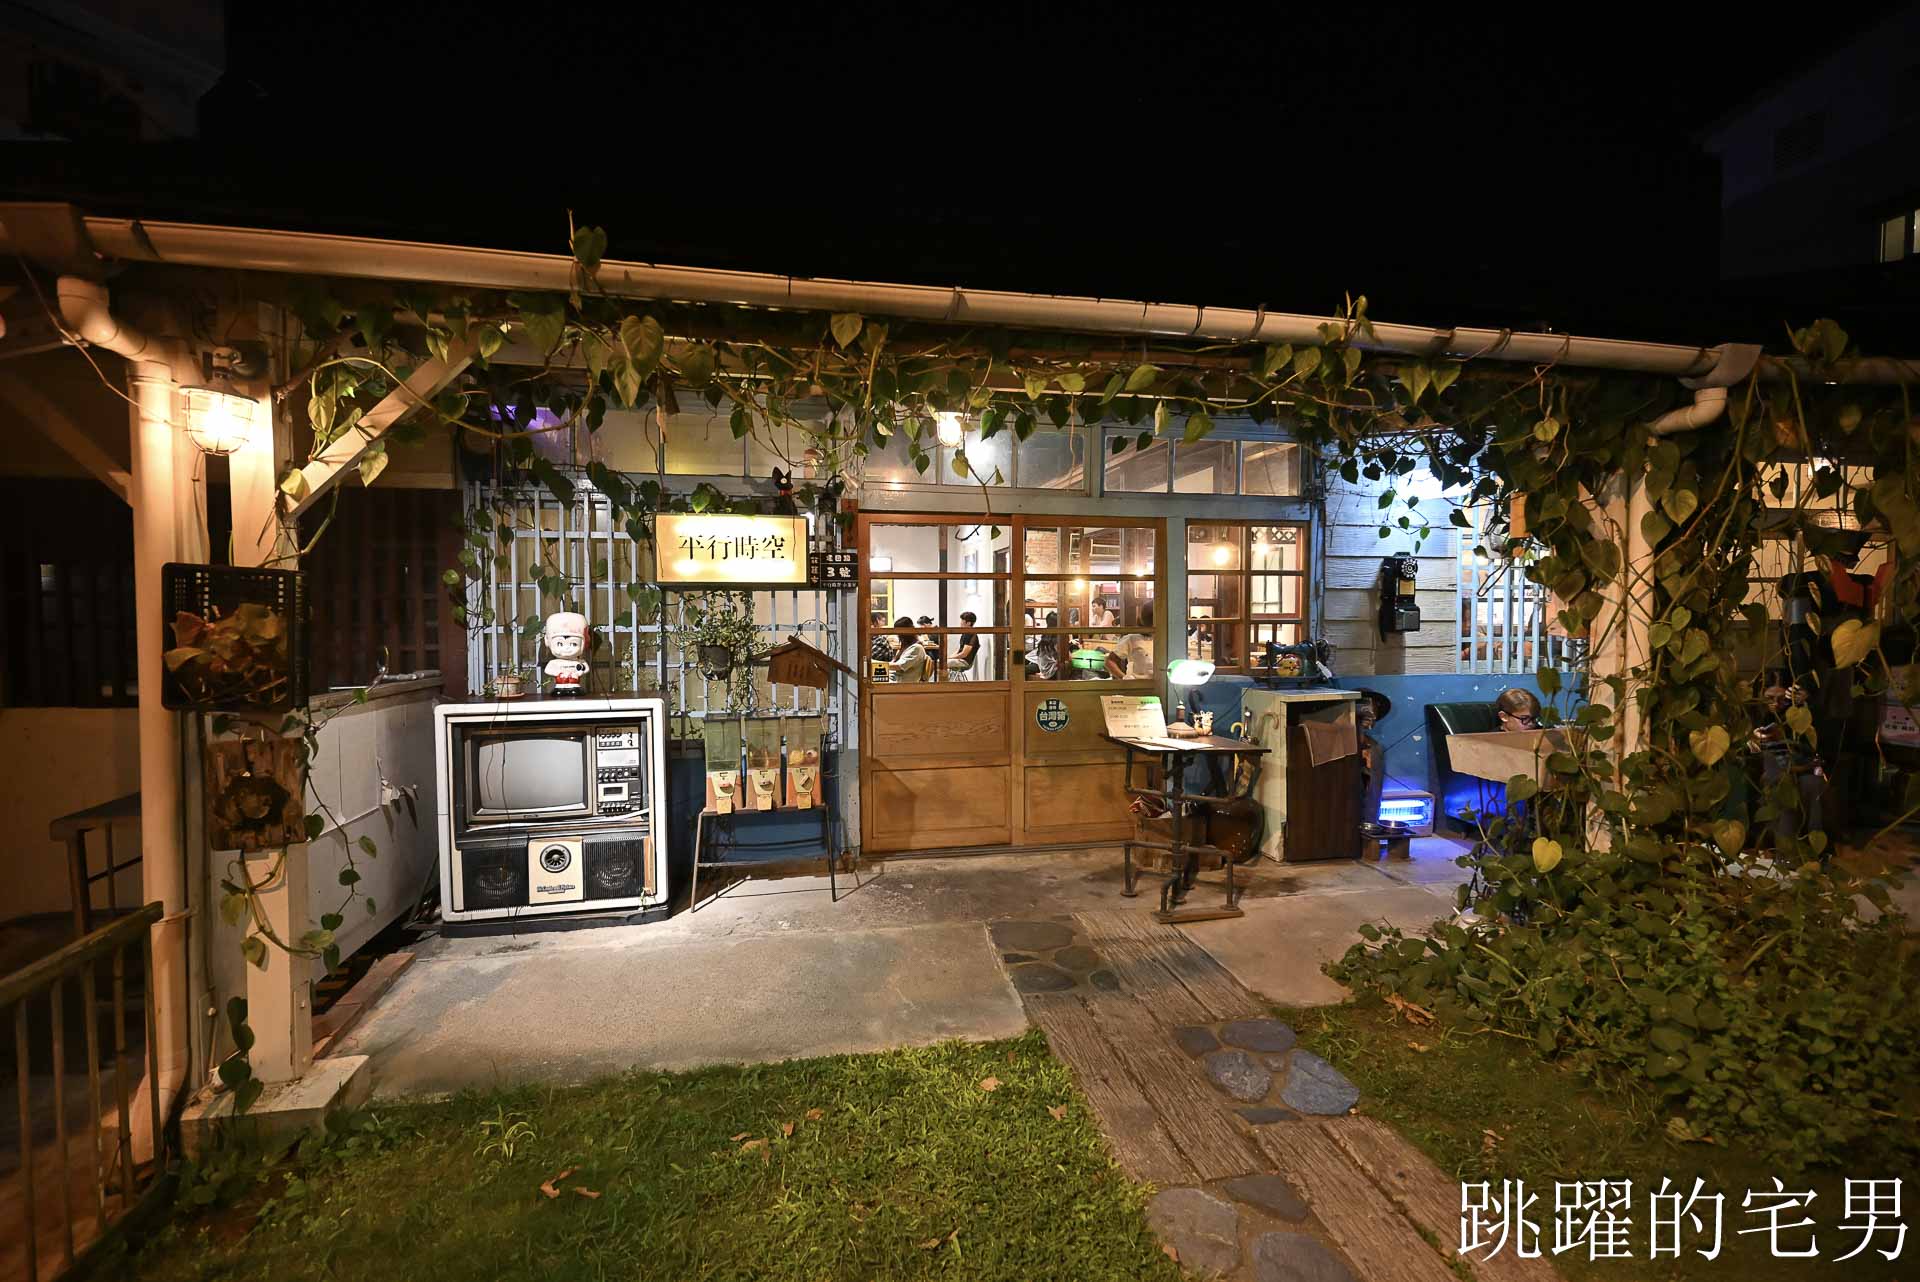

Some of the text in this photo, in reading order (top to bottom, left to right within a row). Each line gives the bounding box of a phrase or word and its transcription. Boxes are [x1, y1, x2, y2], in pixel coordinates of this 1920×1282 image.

[678, 534, 786, 560] 平行時空
[826, 566, 852, 578] 3號
